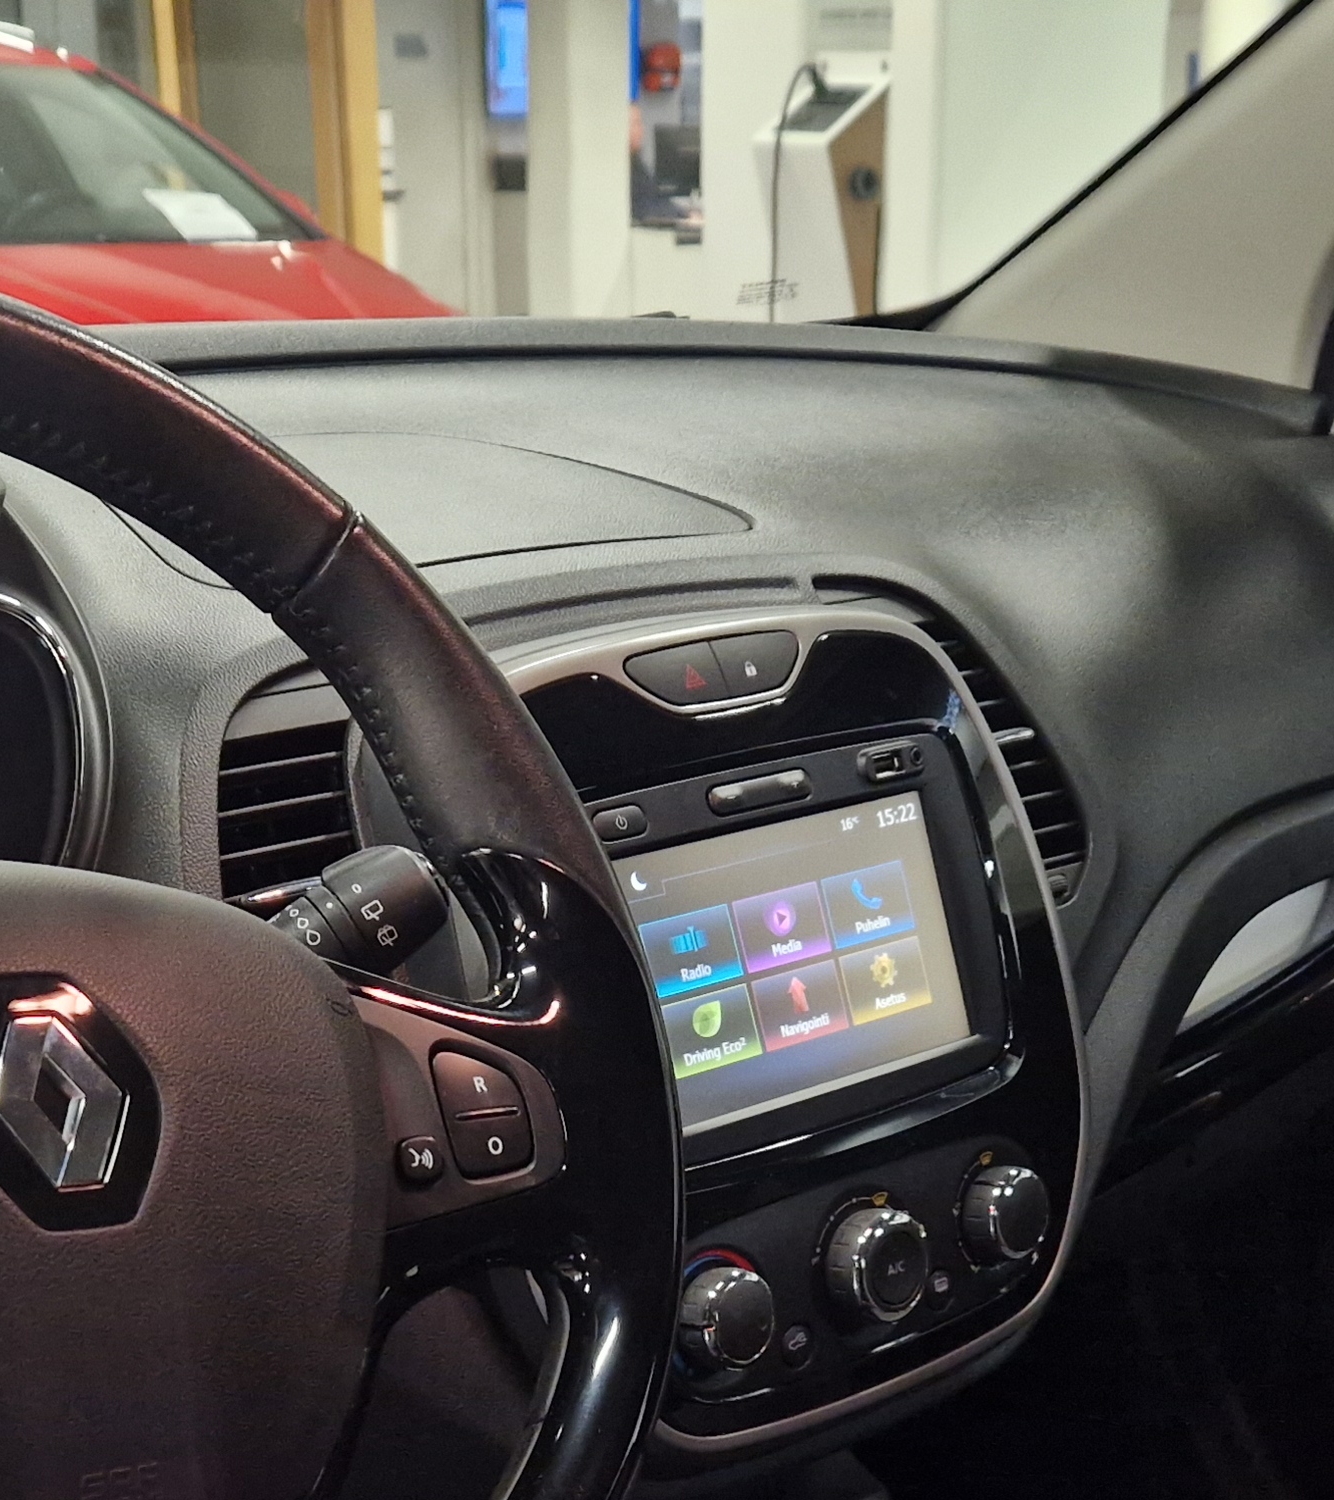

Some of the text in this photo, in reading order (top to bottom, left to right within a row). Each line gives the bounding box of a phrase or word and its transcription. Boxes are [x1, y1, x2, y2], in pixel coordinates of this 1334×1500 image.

[876, 802, 918, 829] 15:22
[854, 914, 891, 935] Puhelin
[771, 938, 803, 958] Media
[680, 963, 713, 983] Radio
[874, 992, 907, 1011] Asetus
[780, 1012, 831, 1038] Navigointi
[682, 1046, 723, 1068] Driving
[472, 1075, 489, 1094] R
[887, 1259, 907, 1277] A/C
